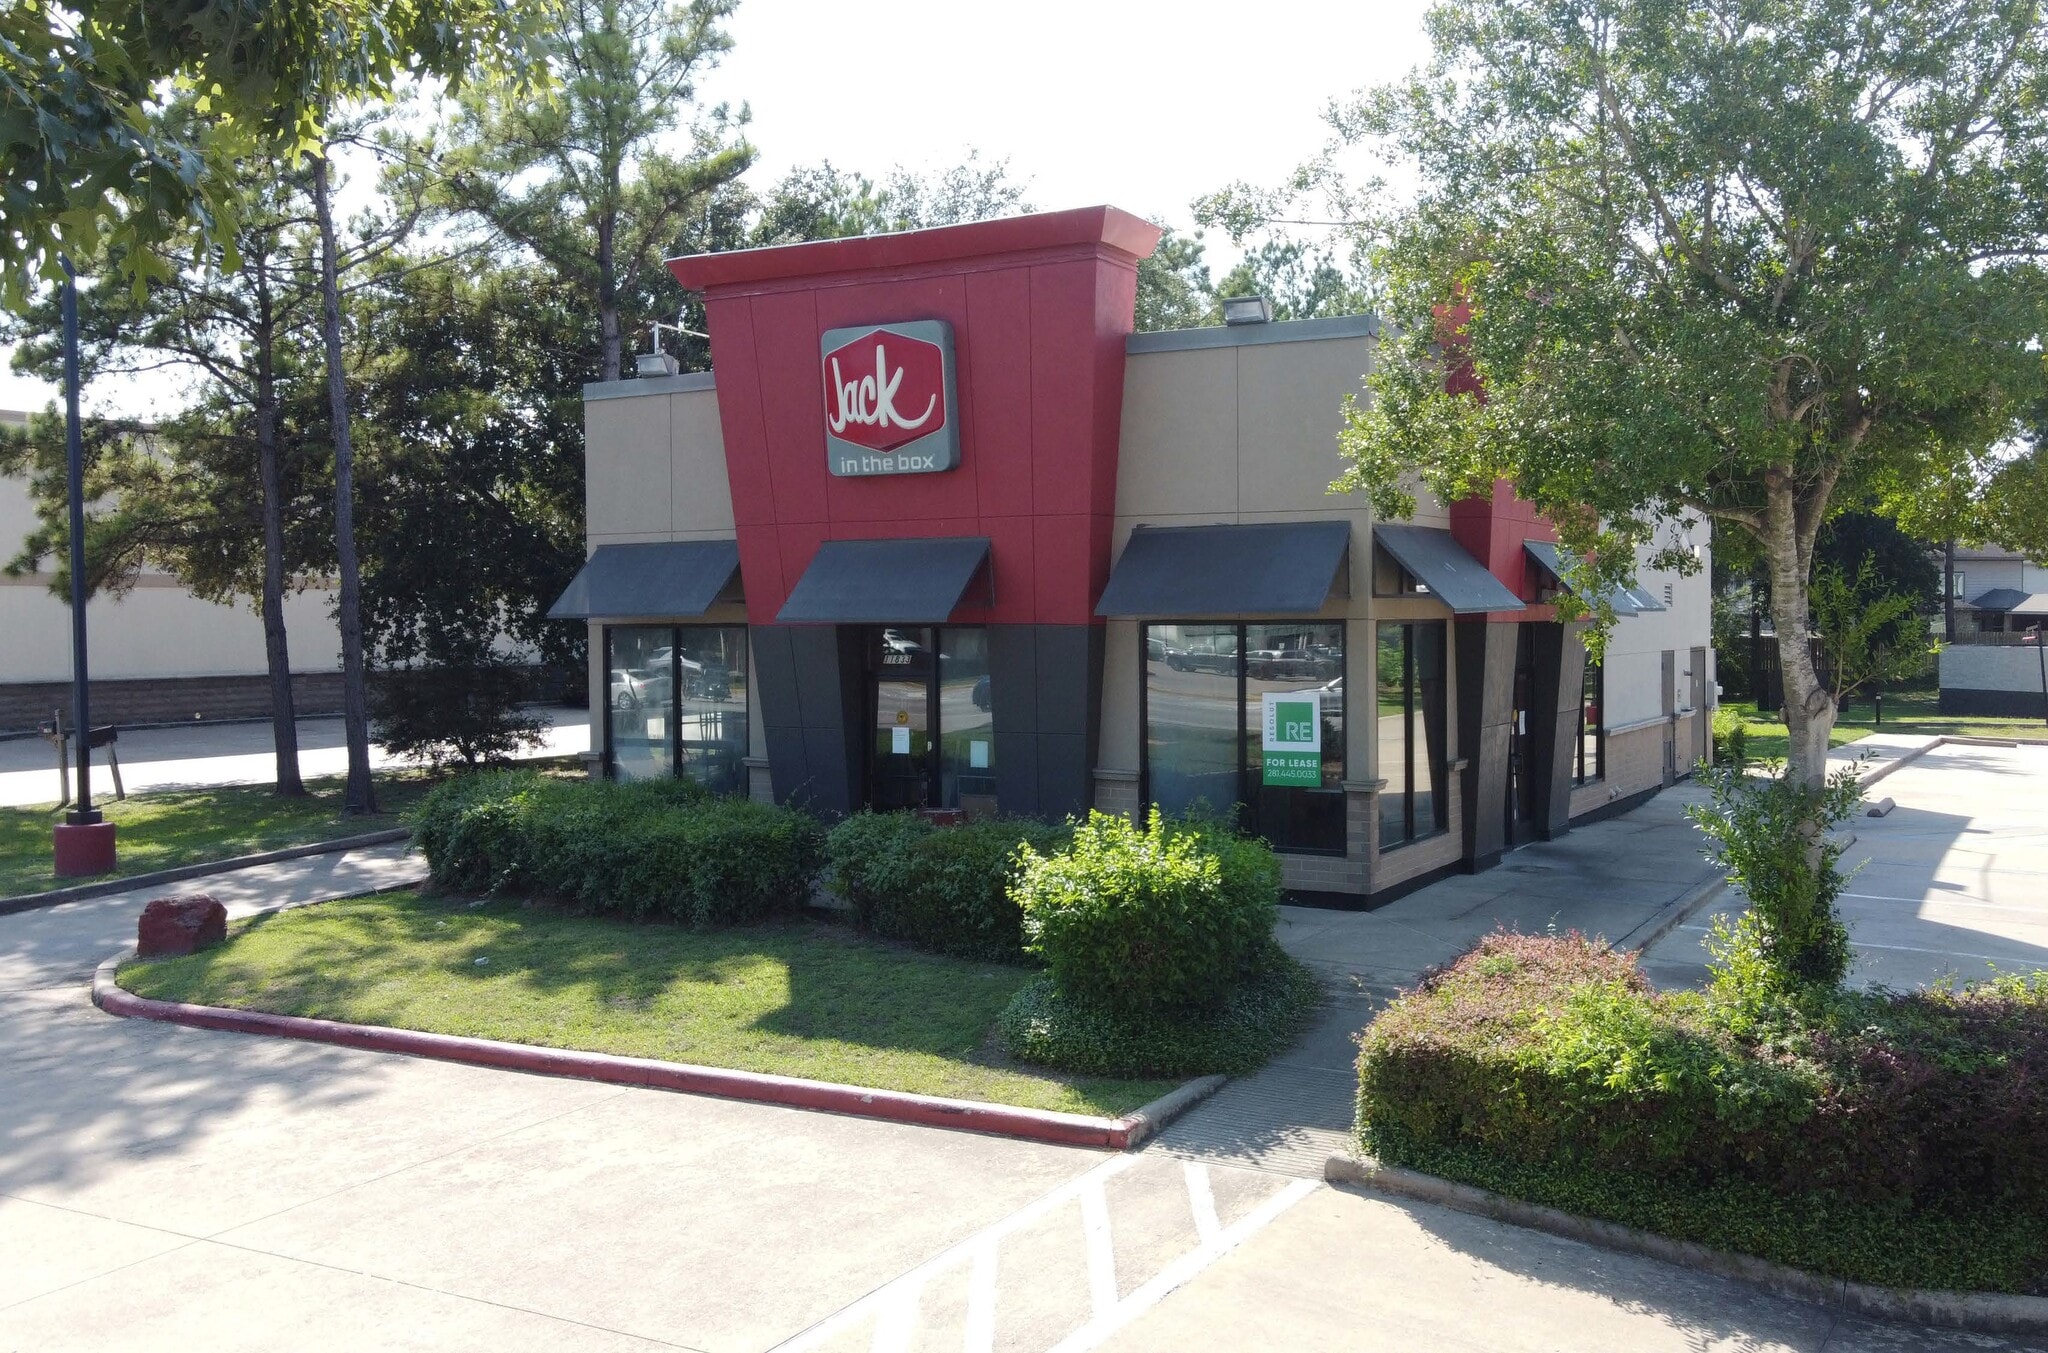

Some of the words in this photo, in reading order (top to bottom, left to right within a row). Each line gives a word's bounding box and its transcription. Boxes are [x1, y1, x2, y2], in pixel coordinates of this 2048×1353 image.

[828, 344, 936, 433] Jack
[841, 457, 858, 473] in
[862, 455, 893, 472] the
[898, 454, 934, 470] box
[1285, 721, 1312, 741] RE
[1266, 758, 1285, 767] FOR
[1288, 759, 1318, 768] LEASE
[1267, 769, 1317, 779] 281.445.0033
